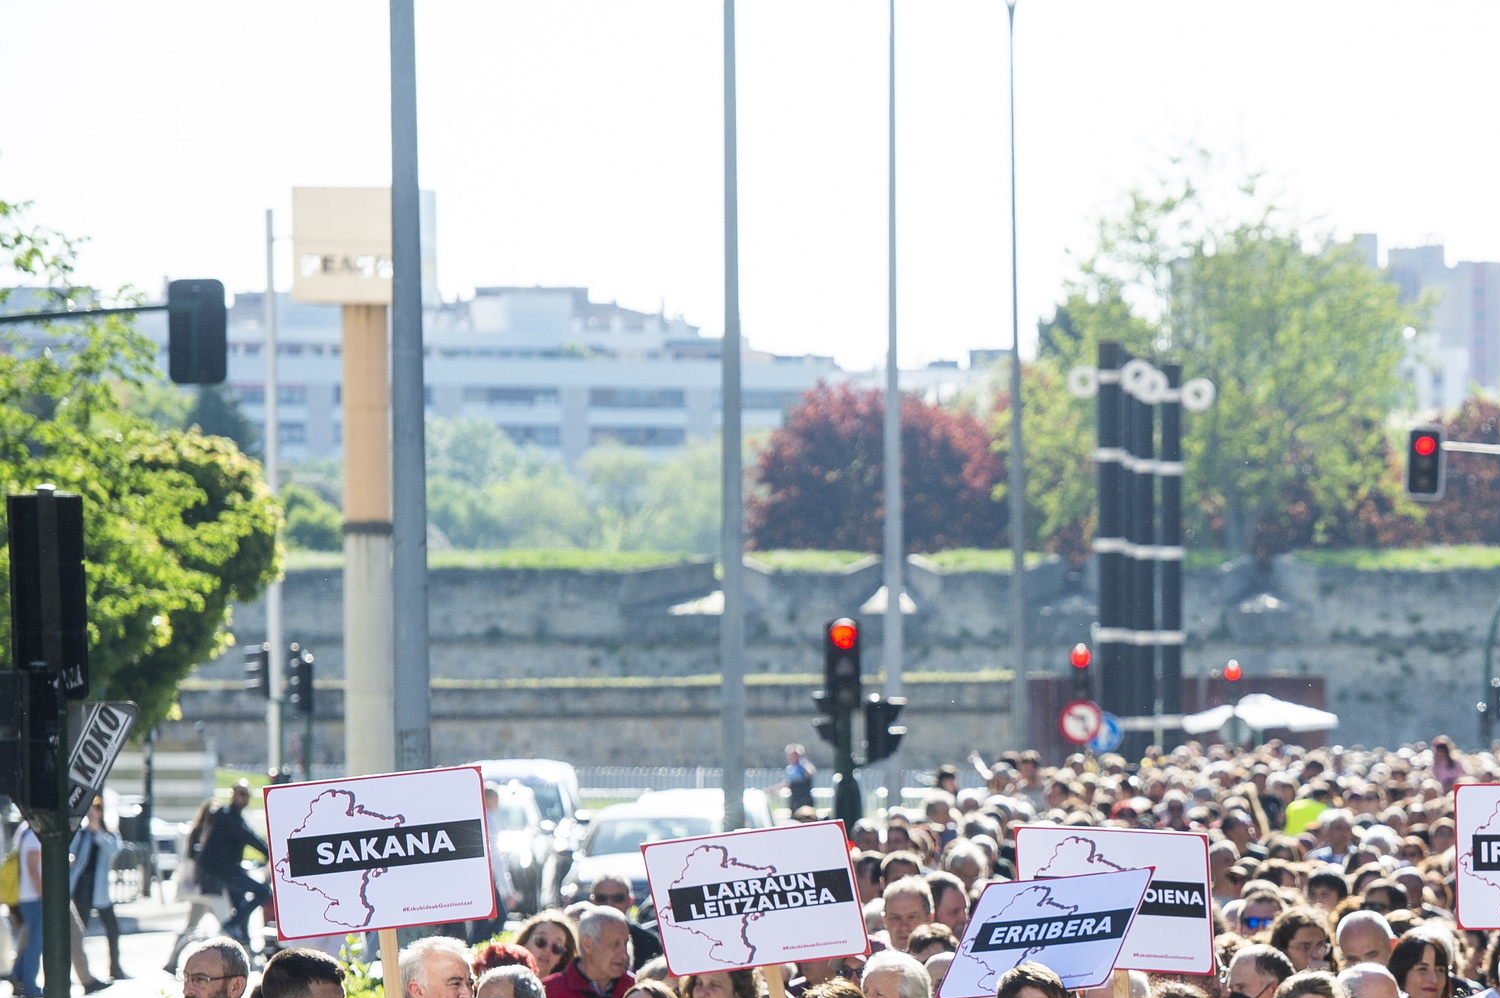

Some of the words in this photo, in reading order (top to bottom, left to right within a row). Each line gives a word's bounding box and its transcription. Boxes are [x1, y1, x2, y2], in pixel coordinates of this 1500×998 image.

[72, 706, 120, 783] KOKO
[316, 829, 456, 866] SAKANA
[702, 872, 816, 901] LARRAUN
[402, 900, 473, 912] #EskubideakGuztiontzat
[690, 888, 837, 920] LEITZALDEA
[988, 915, 1112, 945] ERRIBERA
